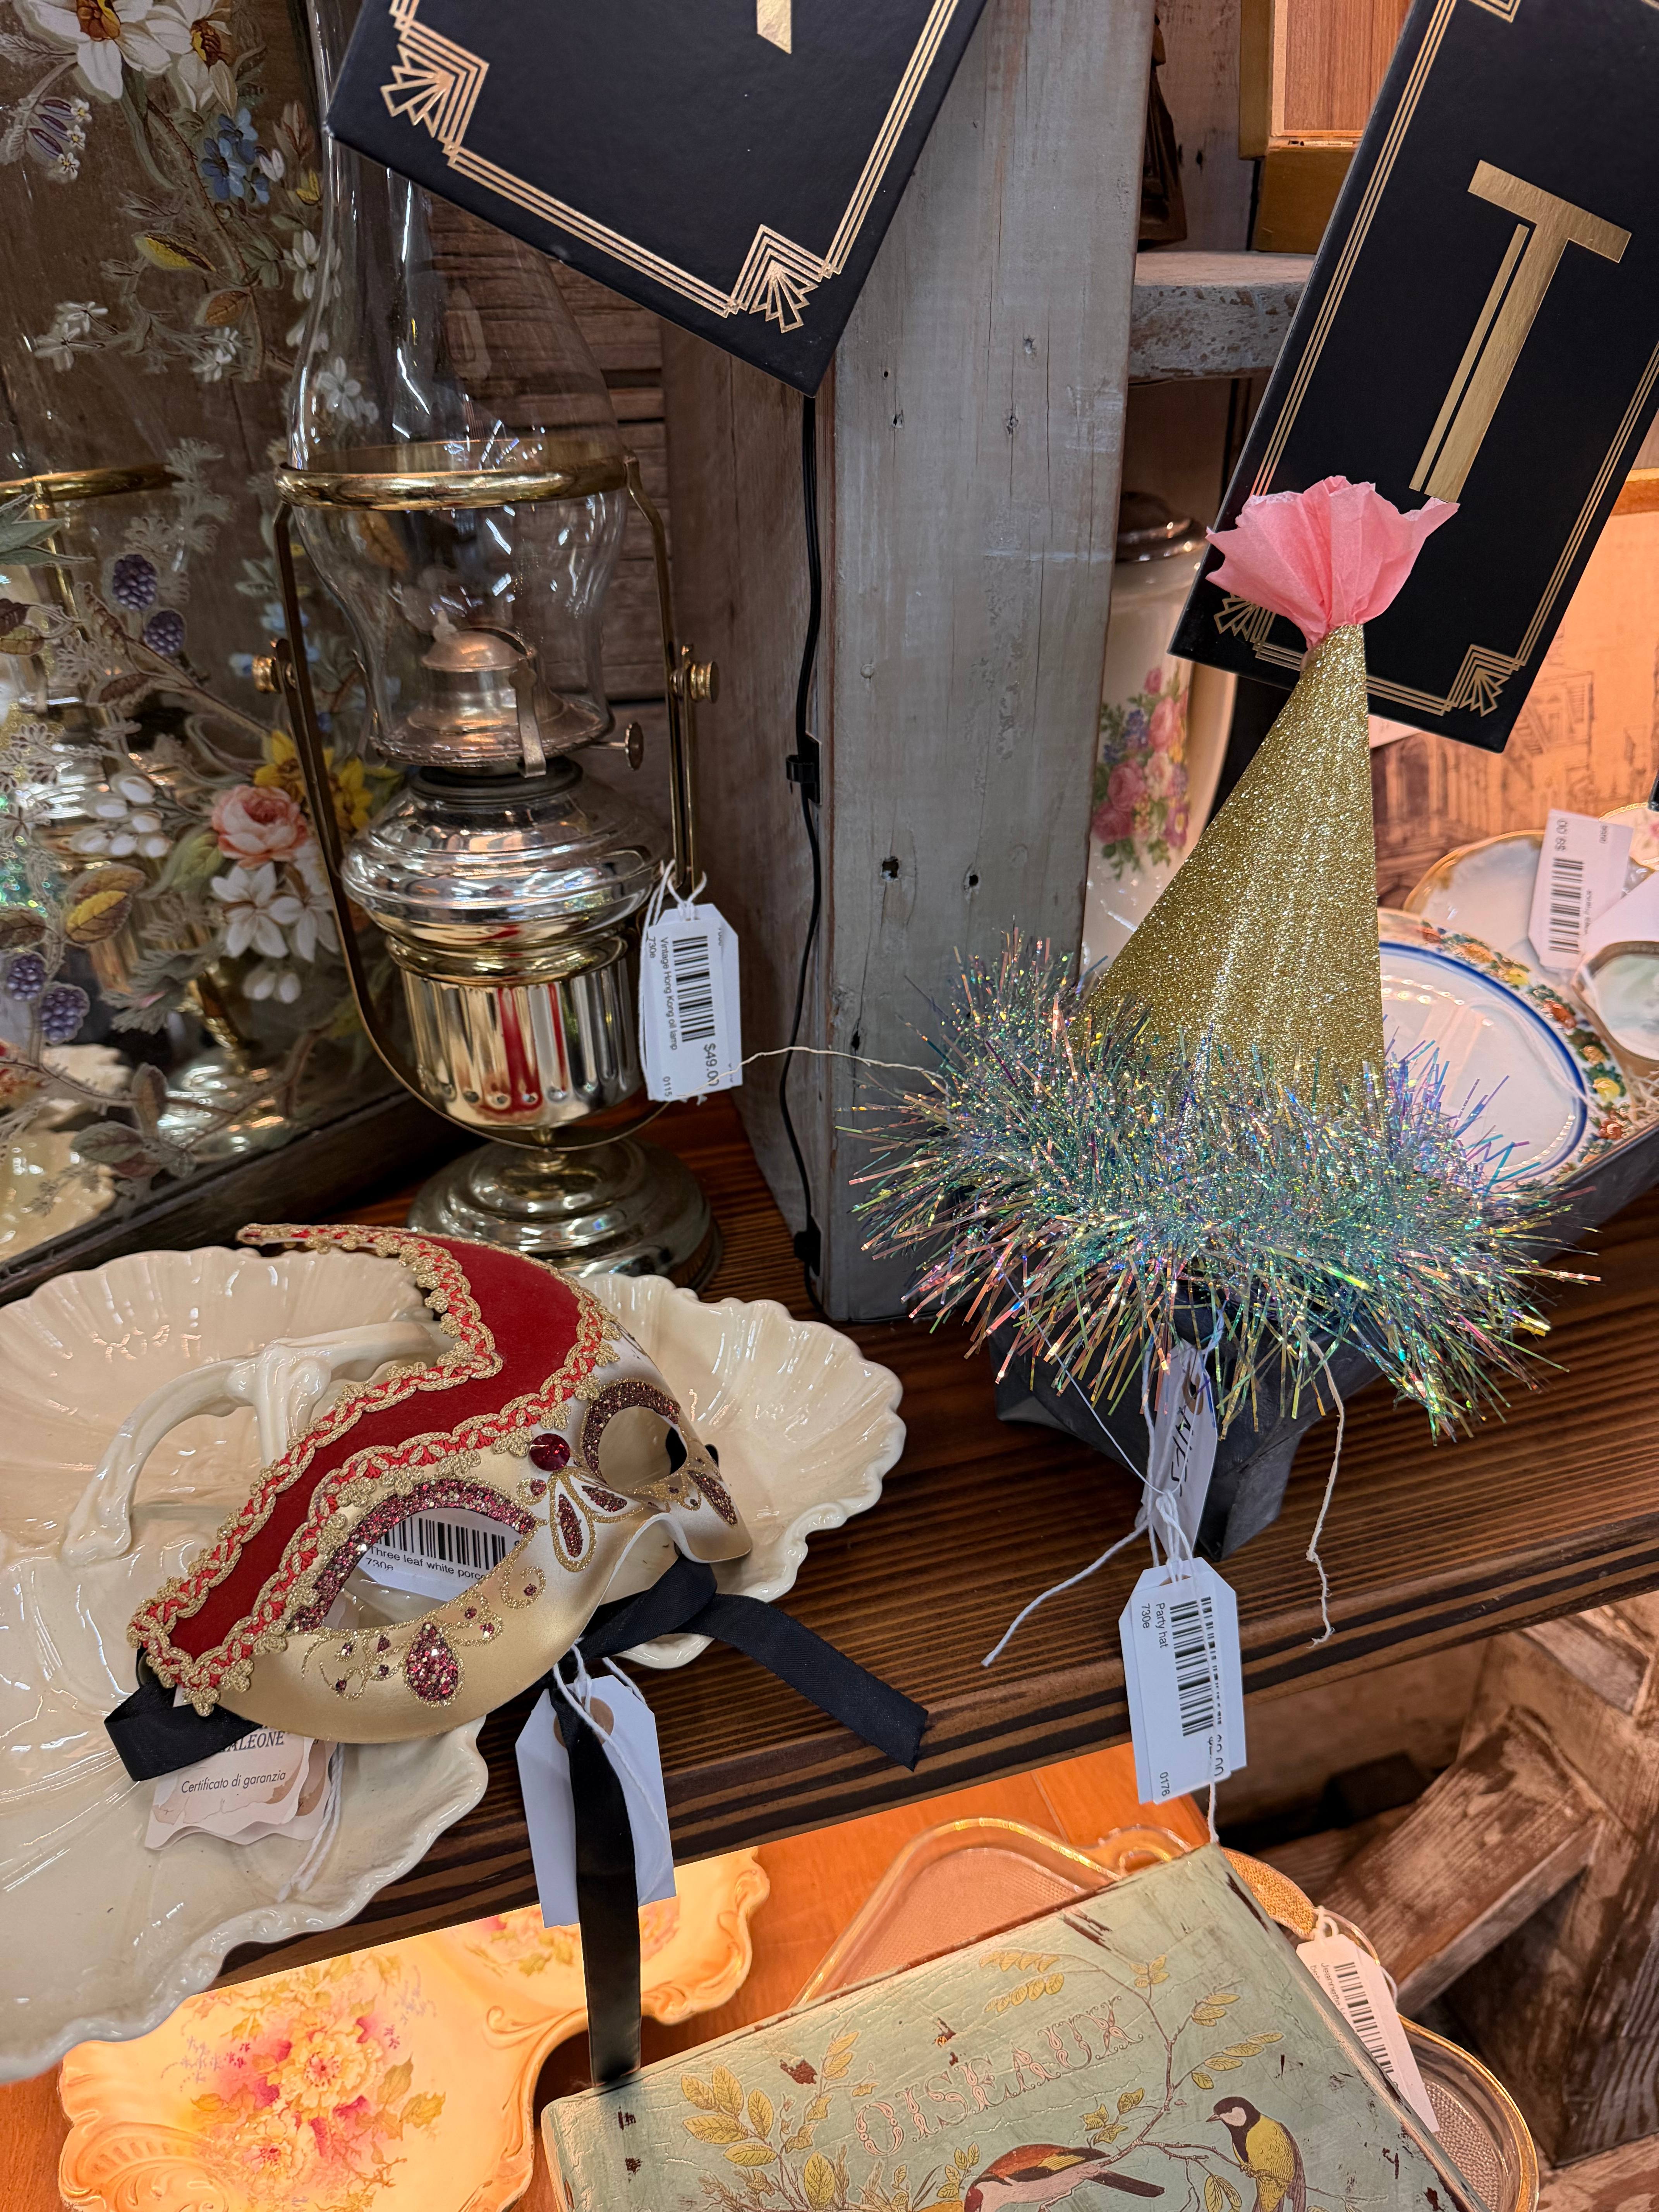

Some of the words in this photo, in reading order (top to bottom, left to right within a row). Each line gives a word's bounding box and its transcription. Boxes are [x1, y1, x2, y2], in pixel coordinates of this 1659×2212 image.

[1409, 159, 1632, 503] T
[648, 936, 657, 958] 730e
[660, 937, 671, 969] Vintage
[663, 971, 673, 994] Hong
[665, 996, 675, 1017] Kong
[668, 1019, 677, 1029] oil
[669, 1030, 678, 1050] lamp
[703, 1042, 720, 1087] $49.00
[663, 1076, 673, 1097] 0115
[370, 1546, 400, 1561] Three
[404, 1554, 423, 1567] leaf
[426, 1561, 455, 1574] white
[1141, 1603, 1151, 1629] 730e
[1156, 1602, 1166, 1629] Party
[1158, 1631, 1169, 1649] hat
[181, 1776, 228, 1793] Certificato
[231, 1774, 240, 1787] di
[243, 1770, 286, 1789] garanzia
[1159, 1771, 1170, 1796] 0176
[855, 1996, 1144, 2156] OISEAUX
